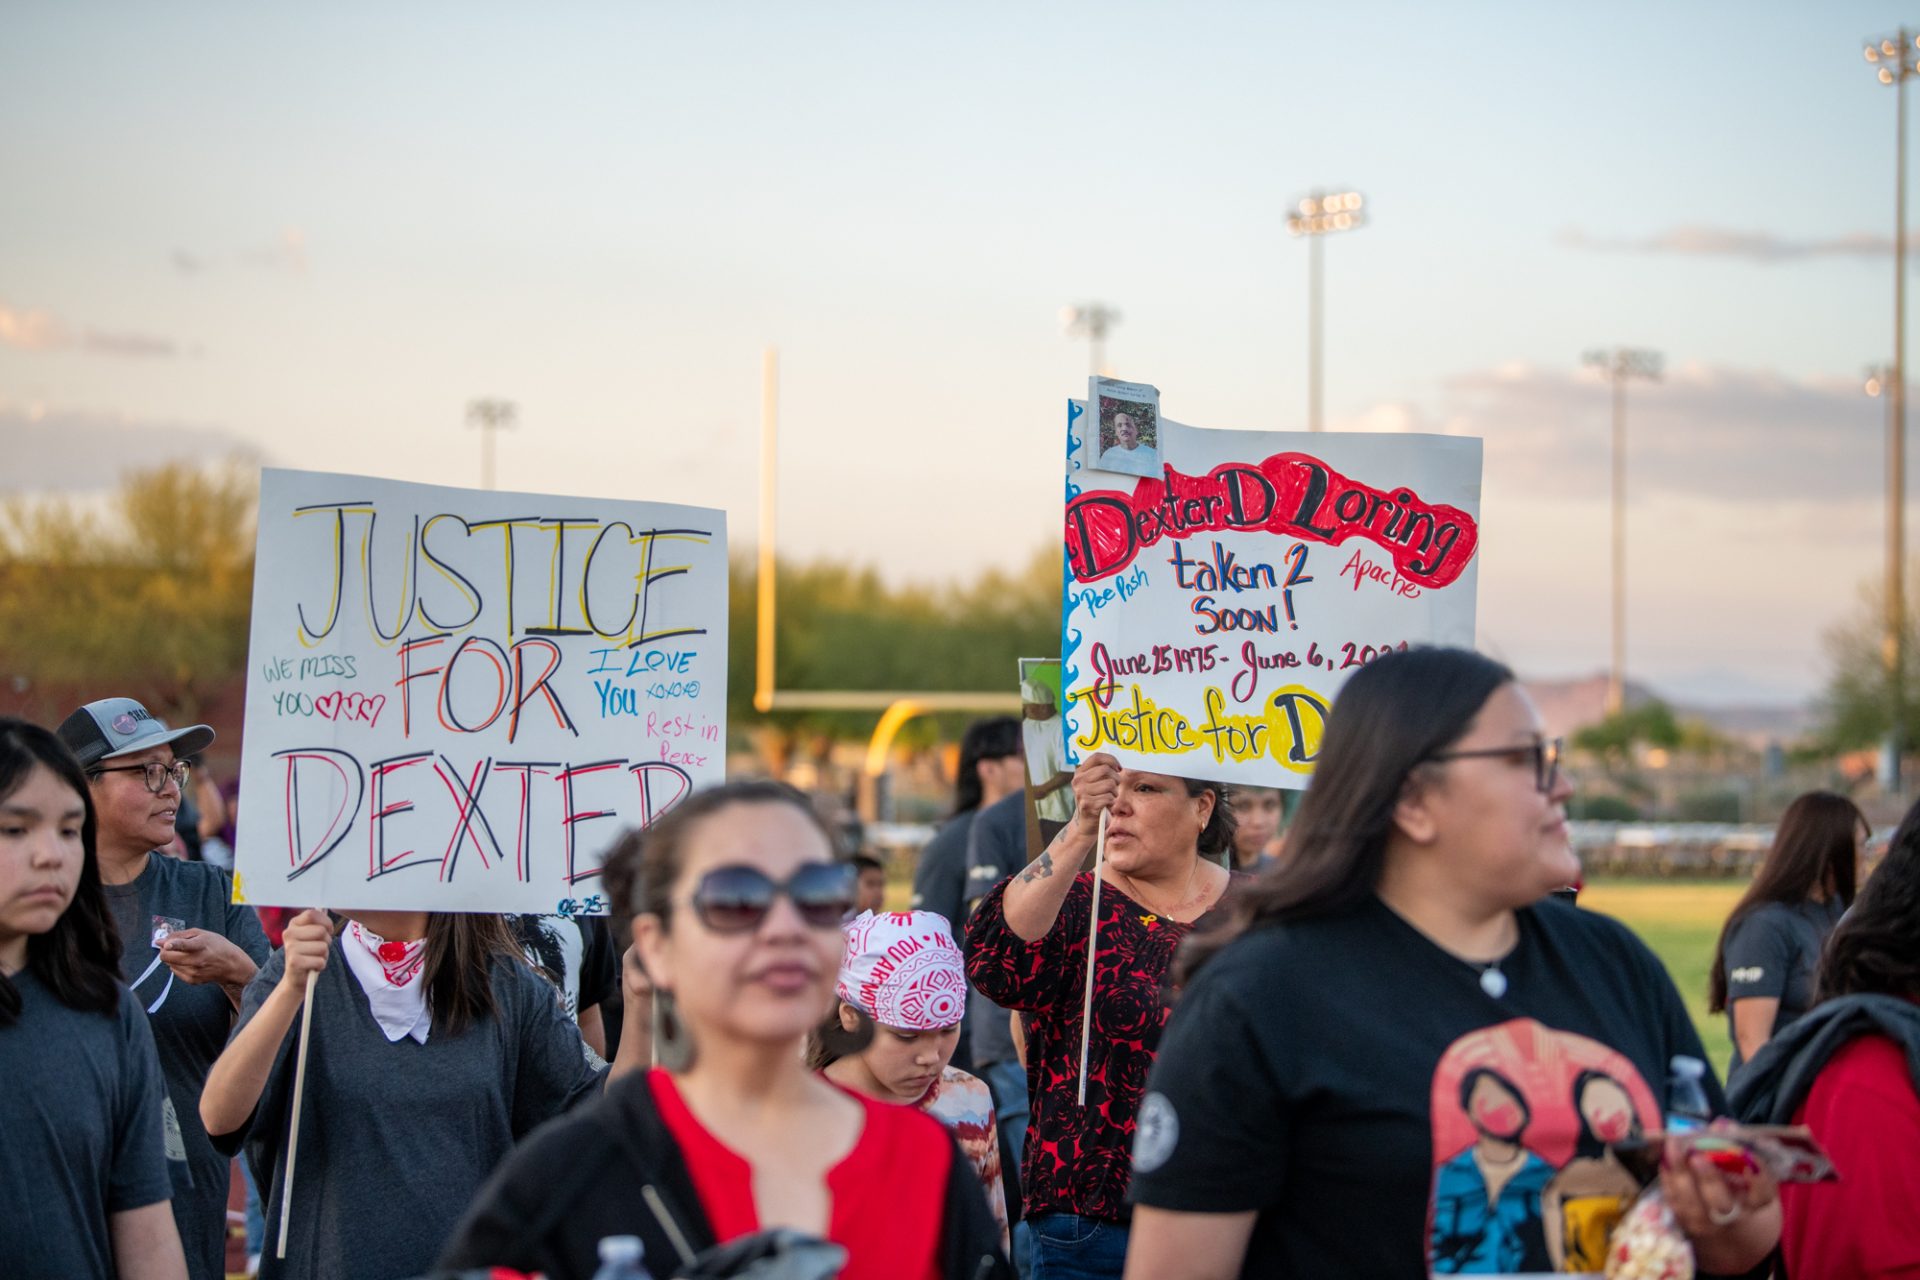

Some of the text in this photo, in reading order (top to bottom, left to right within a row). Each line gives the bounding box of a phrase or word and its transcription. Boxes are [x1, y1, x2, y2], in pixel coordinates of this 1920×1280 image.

[1067, 471, 1223, 577] Dexter
[1291, 463, 1460, 575] Loring
[293, 502, 712, 648] JUSTICE
[1081, 564, 1149, 618] Pee Posh
[1167, 540, 1313, 592] taken 2
[1340, 548, 1420, 599] Apache
[263, 655, 357, 682] WE MISS
[395, 633, 579, 744] FOR
[587, 649, 697, 677] I LOVE
[1231, 640, 1301, 703] June
[273, 691, 314, 716] YOU
[647, 711, 718, 741] Rest in
[1069, 685, 1194, 752] Justice
[1203, 689, 1267, 758] for
[870, 956, 896, 984] AR
[887, 935, 924, 963] YOU
